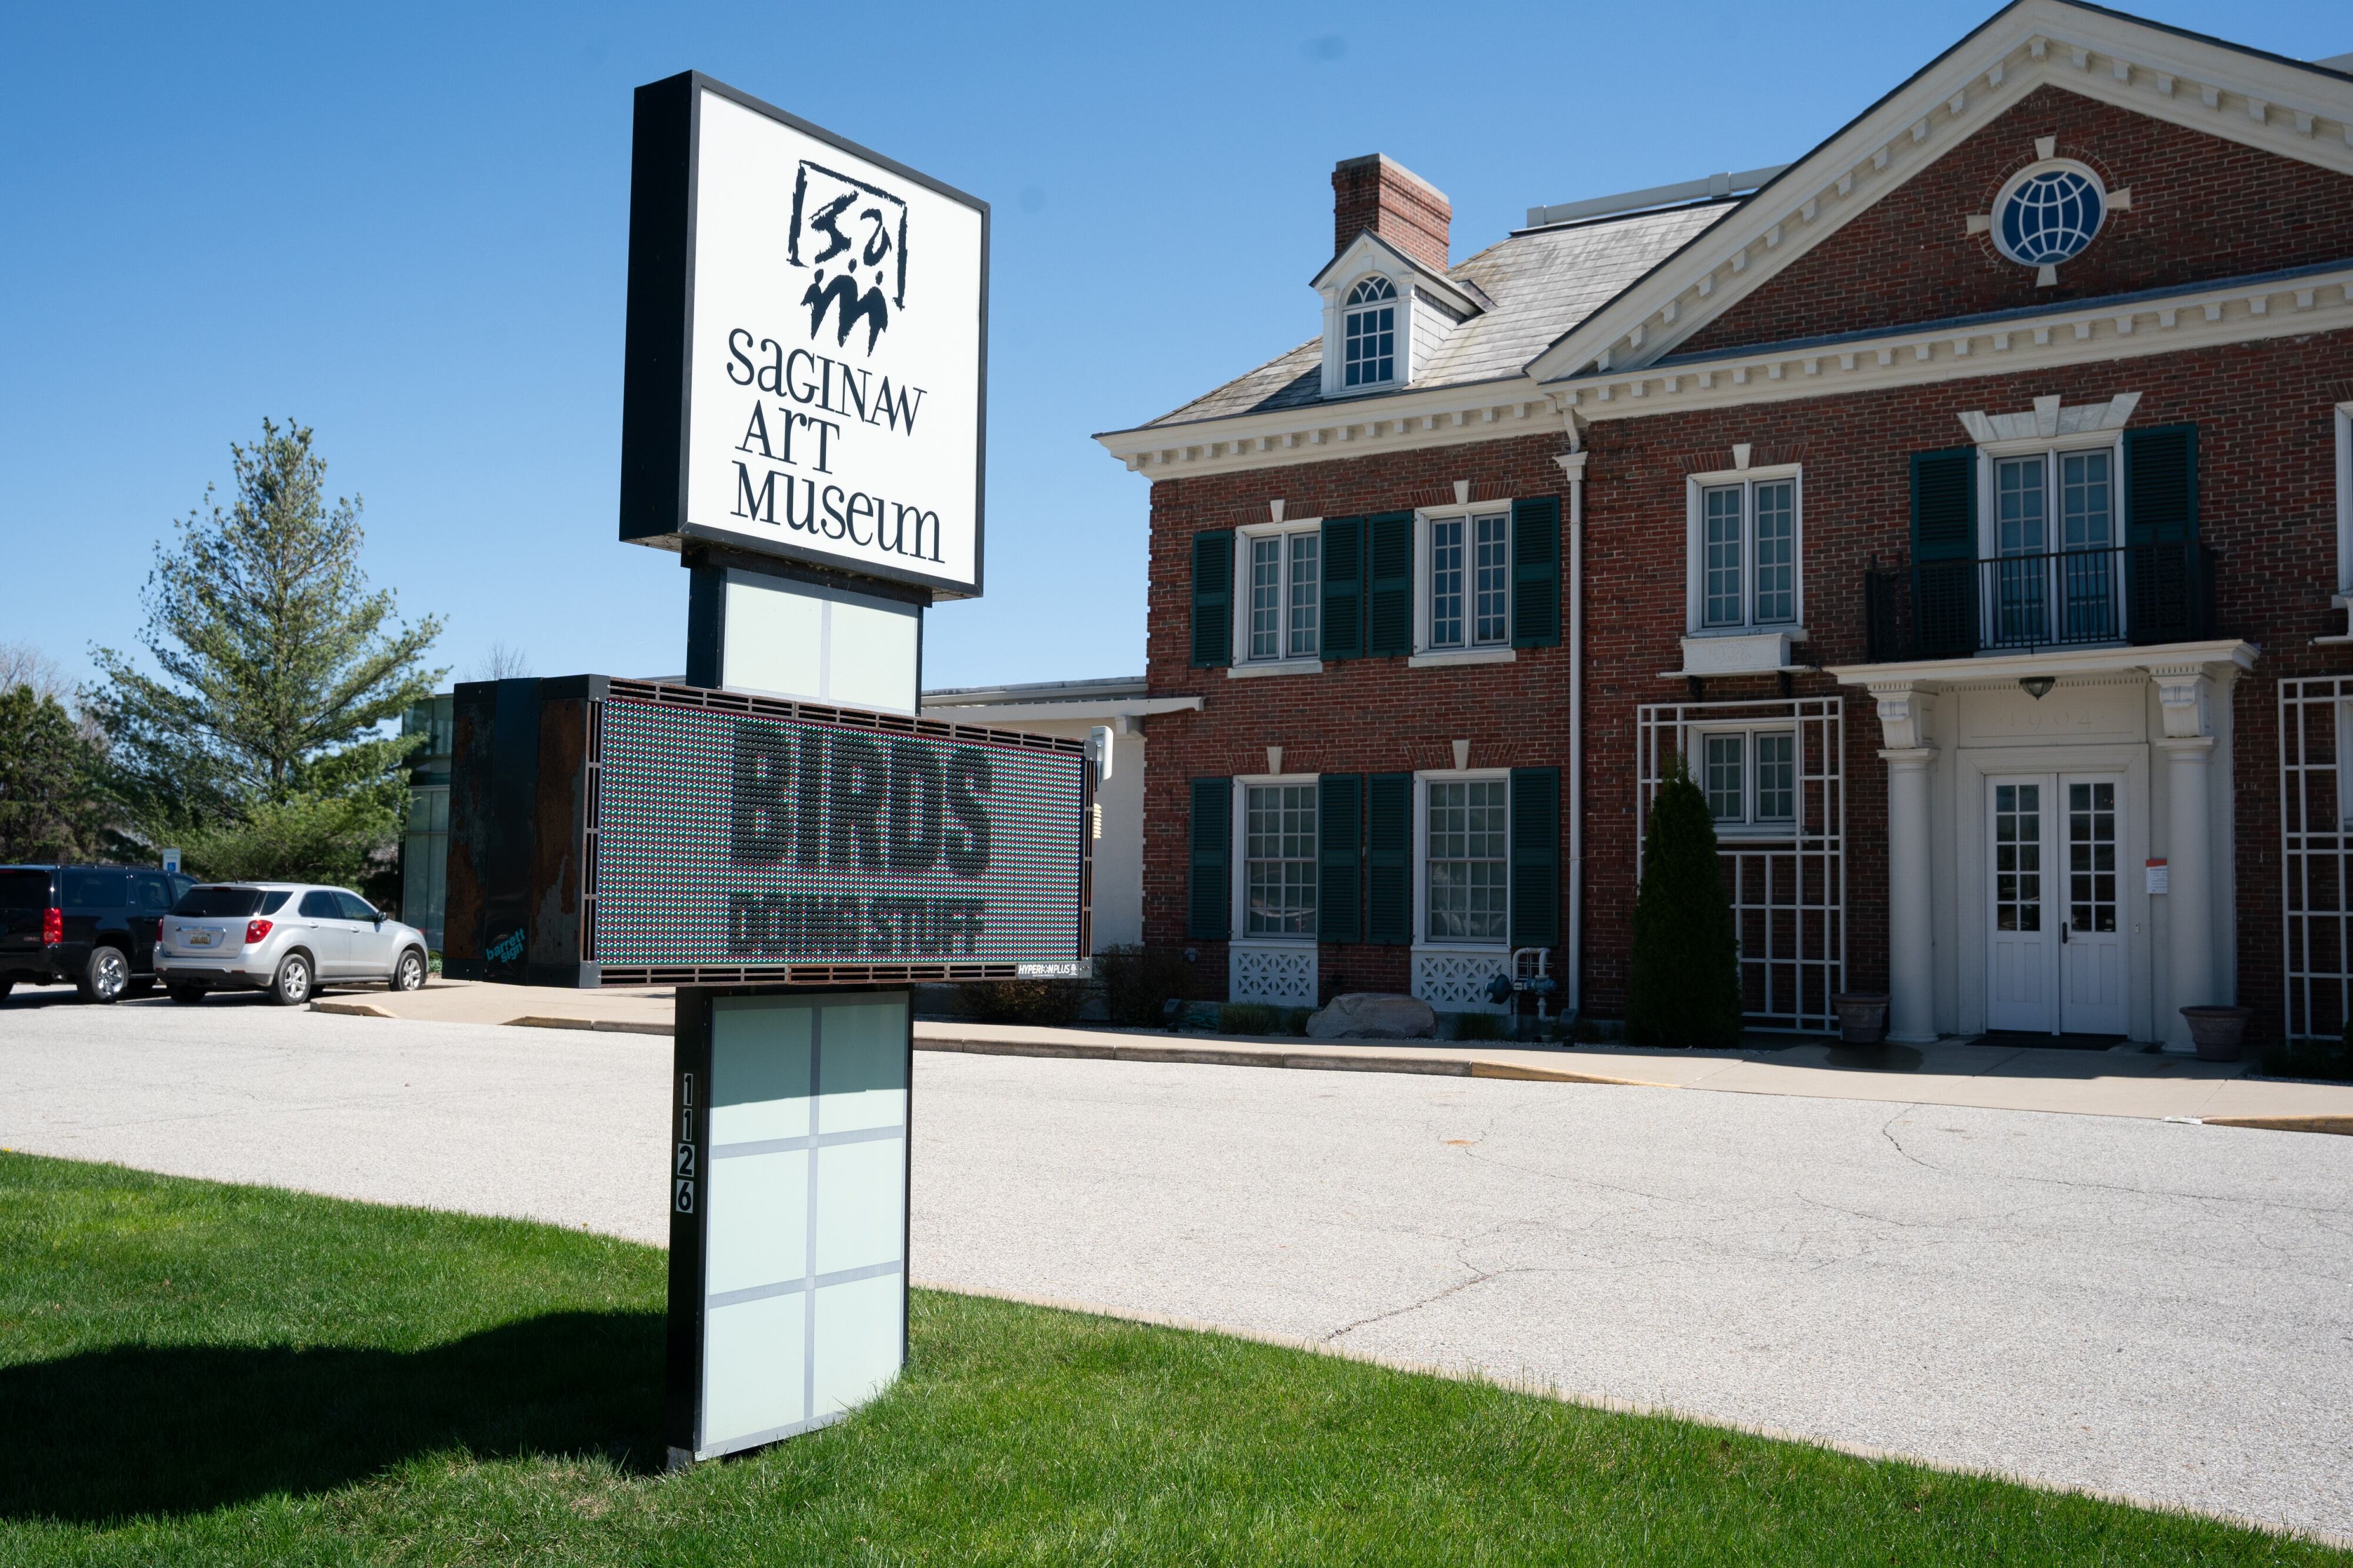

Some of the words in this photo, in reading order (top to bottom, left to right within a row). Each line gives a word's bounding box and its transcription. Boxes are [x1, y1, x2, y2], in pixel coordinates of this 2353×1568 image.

[730, 721, 991, 877] BIRDS
[486, 929, 525, 961] barrett
[728, 893, 860, 956] DOING
[868, 898, 984, 957] STUFF
[501, 942, 523, 962] sign
